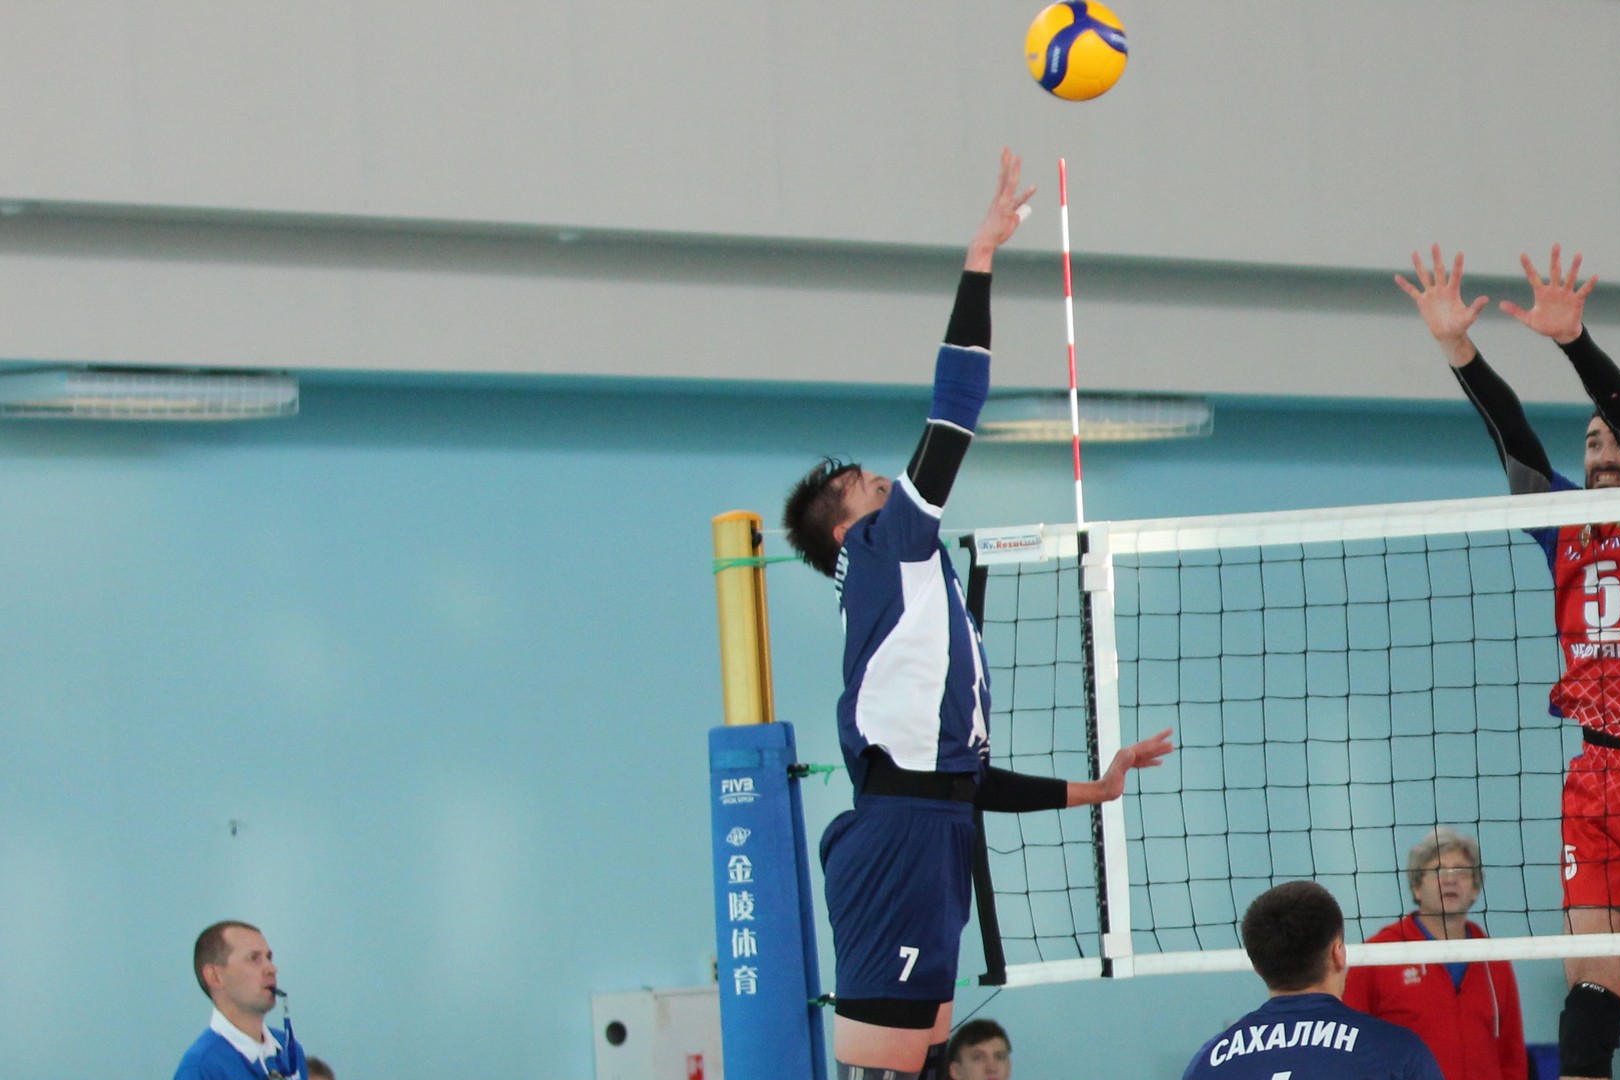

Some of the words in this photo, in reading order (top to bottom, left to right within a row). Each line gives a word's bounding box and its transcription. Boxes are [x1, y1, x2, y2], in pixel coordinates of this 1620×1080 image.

[721, 777, 754, 794] FIVB
[1564, 844, 1578, 881] 5
[727, 855, 759, 996] 金陵体育
[899, 945, 920, 982] 7
[1209, 1020, 1360, 1067] САХАЛИН
